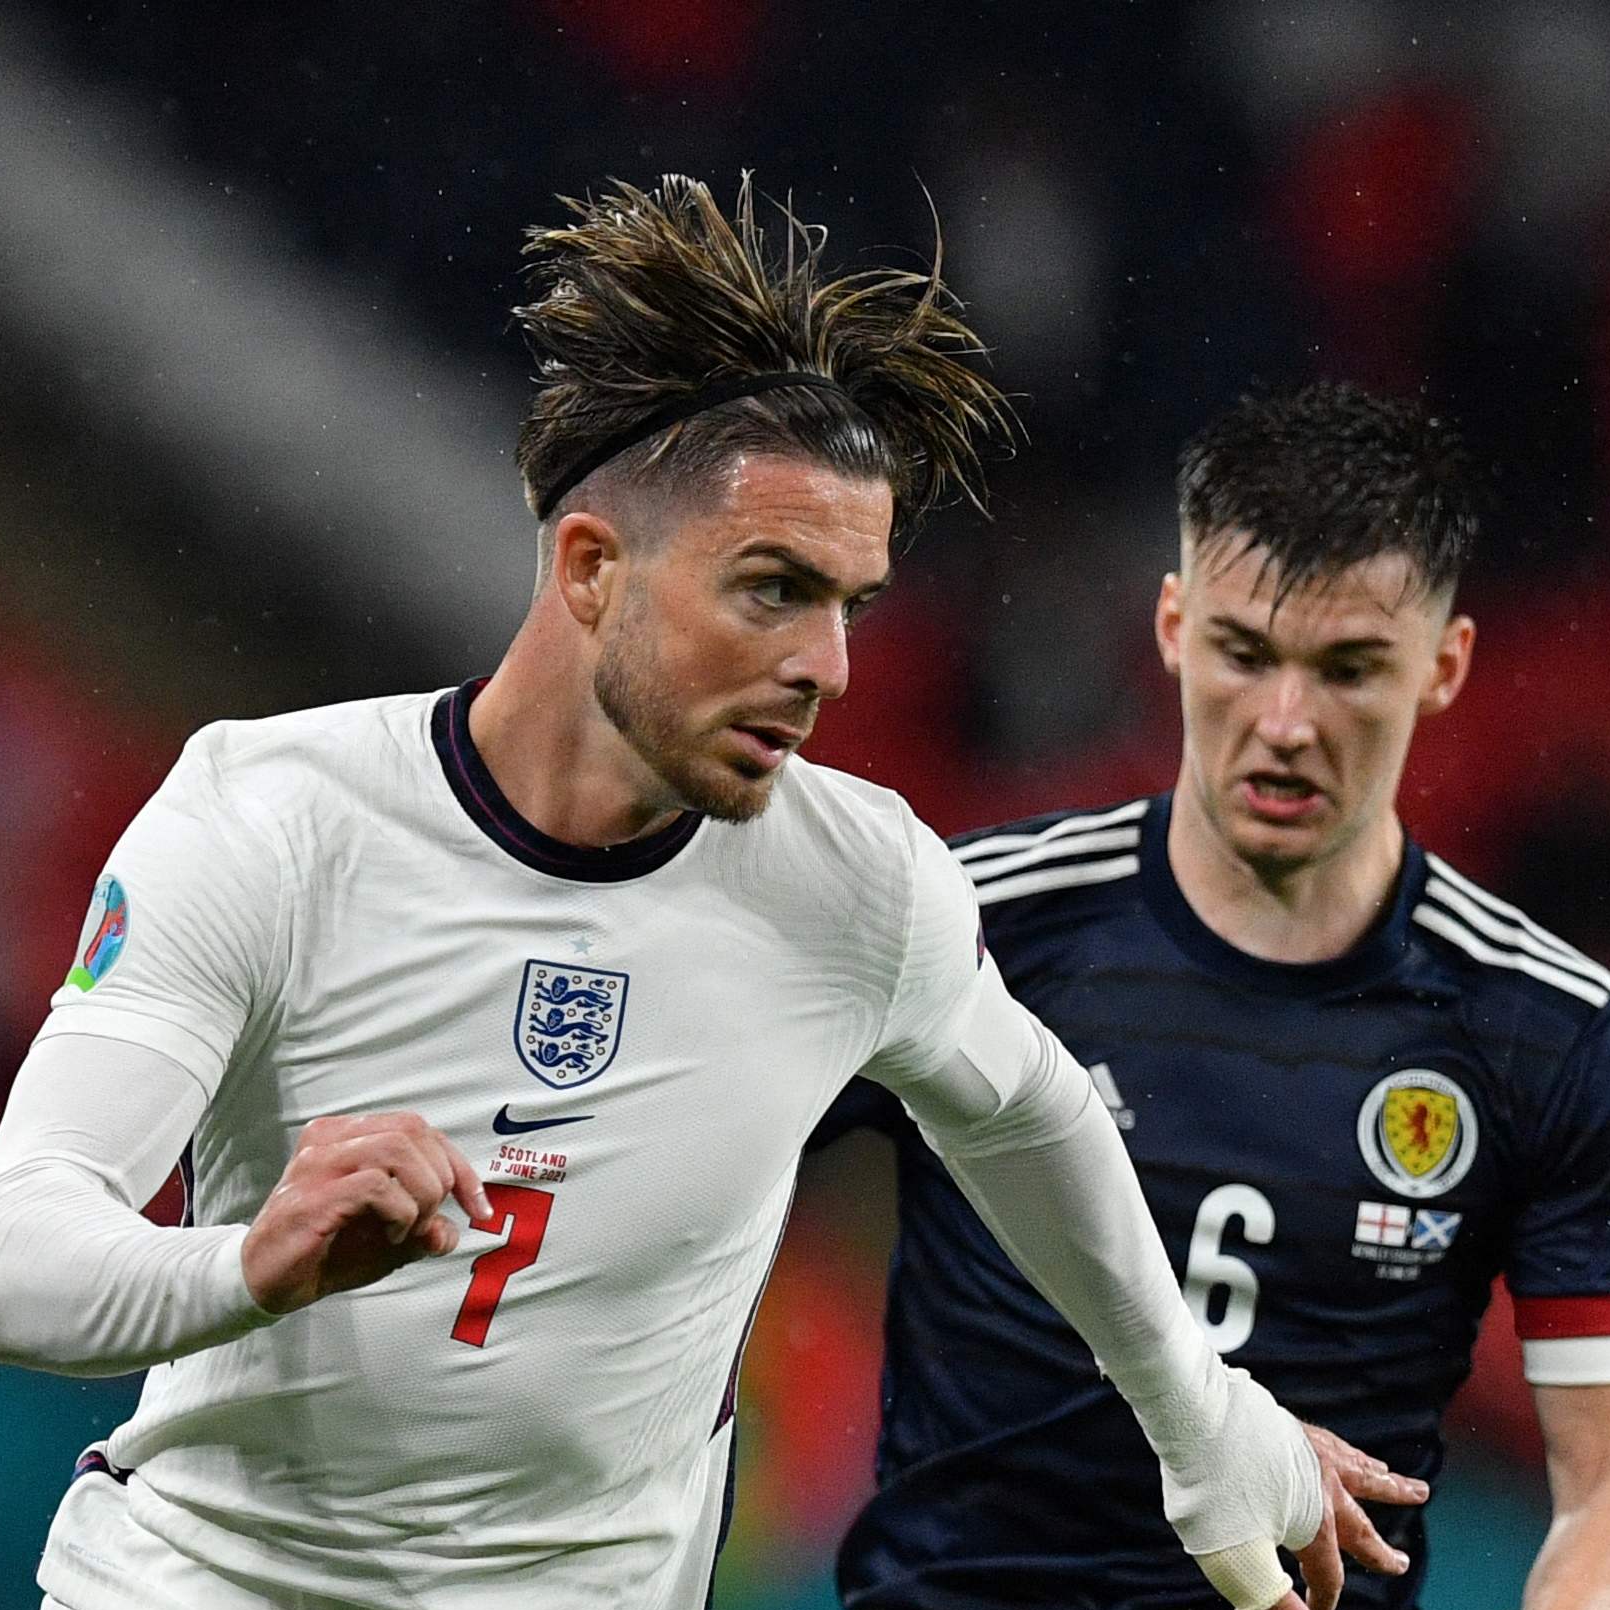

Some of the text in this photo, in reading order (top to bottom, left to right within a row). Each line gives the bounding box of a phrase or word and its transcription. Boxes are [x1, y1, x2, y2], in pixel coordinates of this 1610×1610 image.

[498, 1145, 568, 1169] SCOTLAND
[504, 1163, 538, 1180] JUNE
[539, 1168, 567, 1184] 2021
[451, 1181, 555, 1348] 7
[1183, 1182, 1277, 1355] 6
